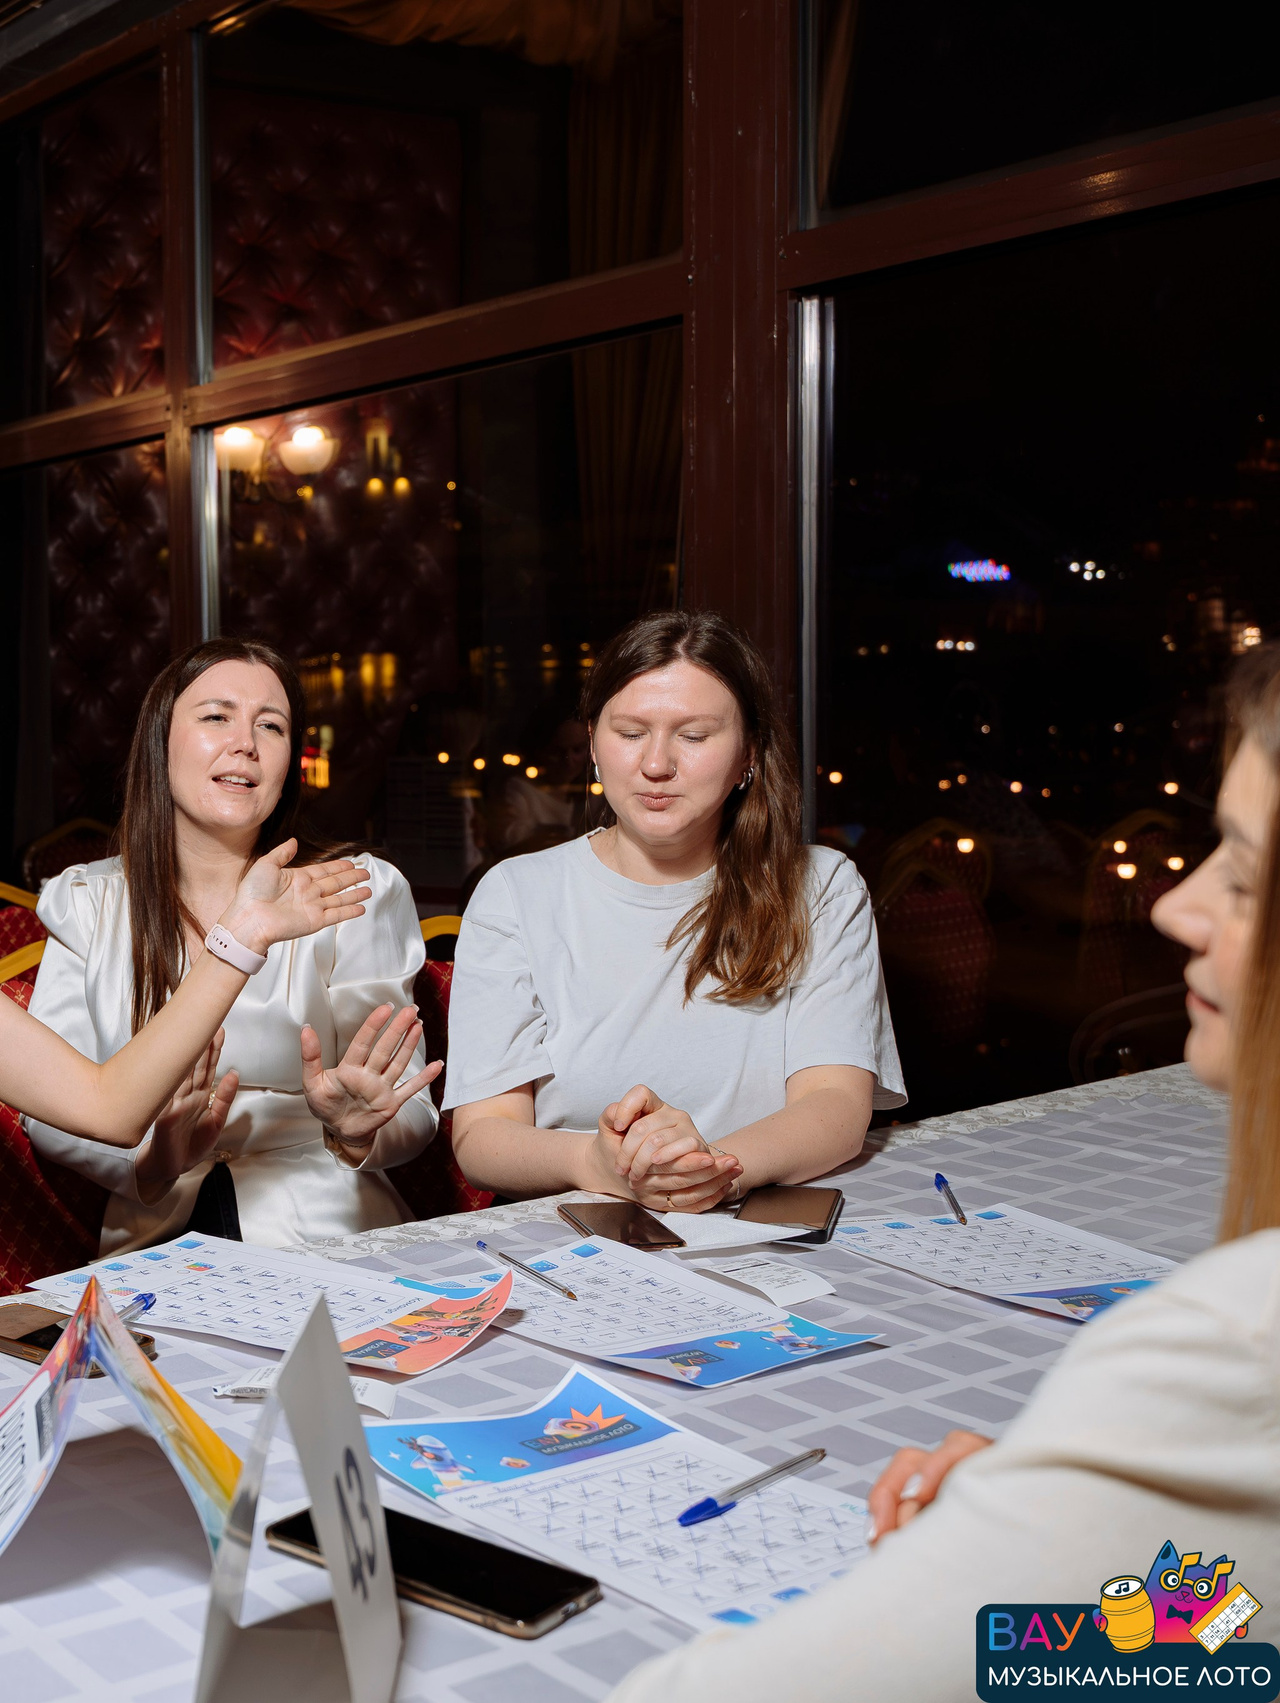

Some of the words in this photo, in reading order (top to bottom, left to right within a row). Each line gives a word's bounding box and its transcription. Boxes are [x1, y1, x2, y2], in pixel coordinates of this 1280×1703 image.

[384, 1296, 423, 1315] Команда
[377, 1343, 408, 1358] ВАУ
[609, 1423, 635, 1440] ЛОТО
[334, 1445, 378, 1605] 43
